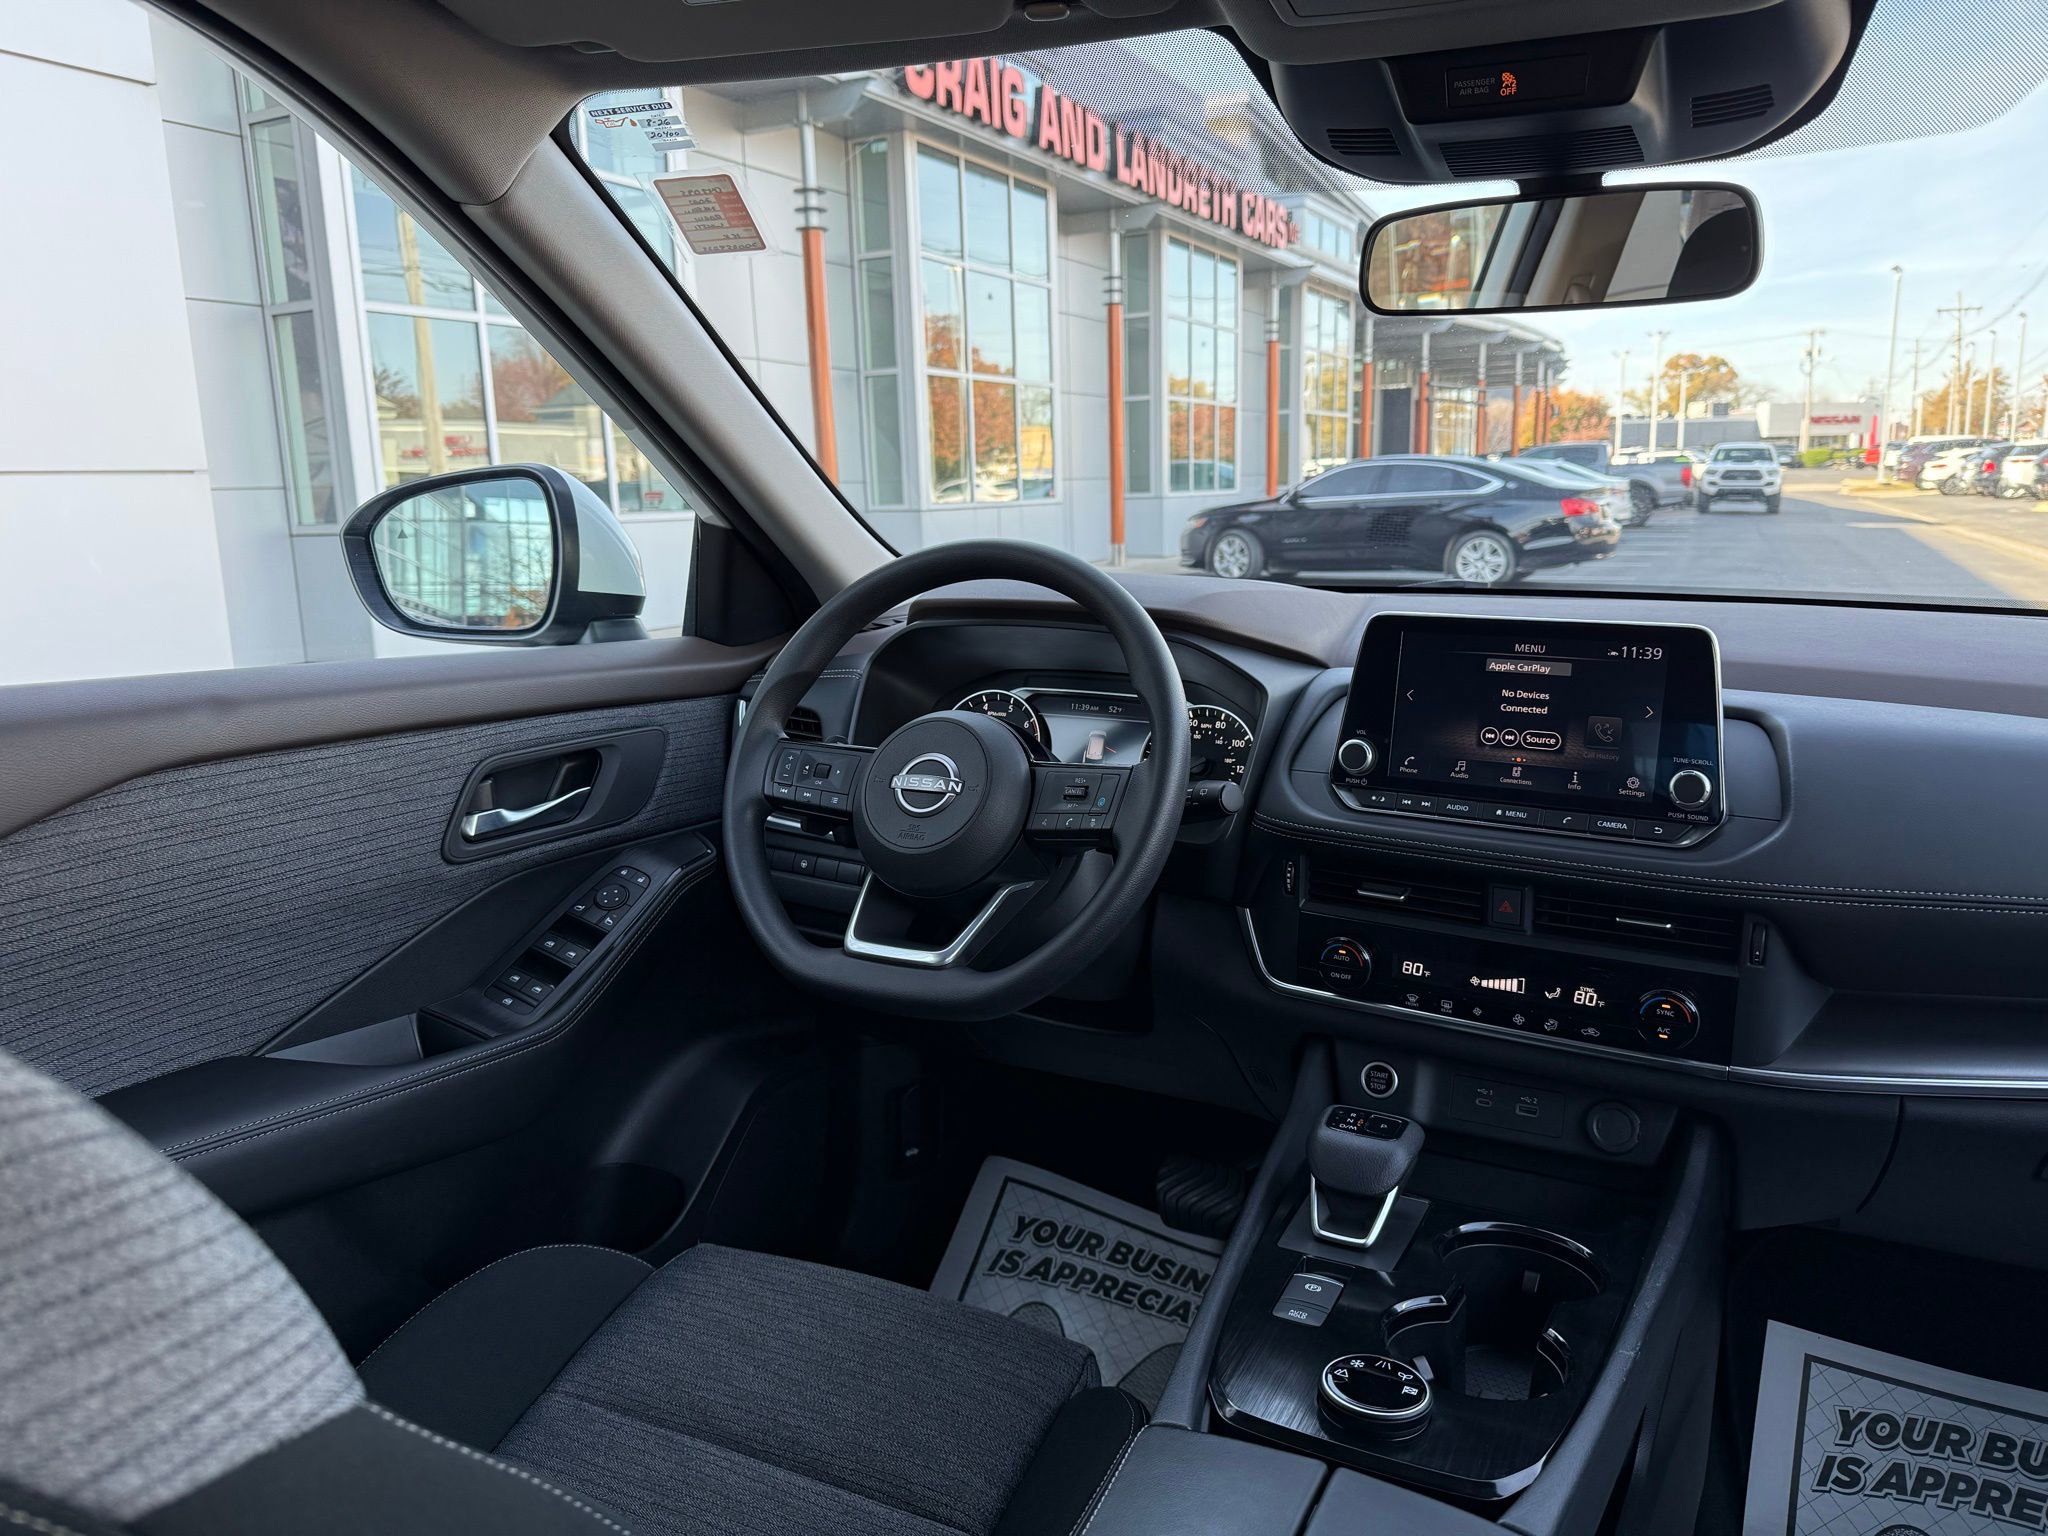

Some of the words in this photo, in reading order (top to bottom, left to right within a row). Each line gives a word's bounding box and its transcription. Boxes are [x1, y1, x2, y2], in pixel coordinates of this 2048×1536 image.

[1454, 77, 1496, 88] PASSENGER
[1459, 88, 1473, 96] AIR
[1474, 86, 1489, 94] BAG
[1500, 88, 1518, 96] OFF
[591, 109, 615, 117] NEXT
[615, 104, 651, 114] SERVICE
[652, 102, 671, 110] DUE
[905, 57, 1027, 138] CRAIG
[1038, 85, 1107, 171] AND
[1115, 124, 1237, 230] LANDRETH
[1242, 192, 1289, 249] CARS
[1514, 643, 1546, 653] MENU
[1621, 646, 1663, 660] 11:39
[1489, 661, 1516, 672] Apple
[1517, 663, 1550, 674] CarPlay
[1501, 689, 1515, 698] No
[1516, 690, 1550, 700] Devices
[983, 703, 988, 711] 4
[1008, 704, 1014, 713] 5
[1500, 704, 1548, 714] Connected
[1024, 720, 1030, 729] 6
[1215, 721, 1227, 729] 80
[1231, 739, 1245, 748] 100
[1525, 734, 1556, 745] Source
[1583, 751, 1597, 759] Call
[1598, 753, 1620, 762] History
[1399, 766, 1418, 774] Phone
[1450, 771, 1469, 779] Audio
[892, 777, 963, 793] NISSAN
[1499, 776, 1532, 786] Connections
[1618, 788, 1645, 797] Settings
[1446, 803, 1469, 812] AUDIO
[1505, 810, 1527, 819] MENU
[1668, 811, 1685, 819] PUSH
[1687, 813, 1709, 821] SOUND
[1597, 820, 1628, 830] CAMERA
[1333, 954, 1350, 962] AUTO
[1656, 1009, 1675, 1017] SYNC
[1657, 1026, 1671, 1034] A/C
[1370, 1070, 1388, 1079] START
[1339, 1123, 1357, 1131] D/M
[1012, 1215, 1105, 1258] YOUR
[1105, 1240, 1211, 1293] BUSIN
[987, 1249, 1028, 1275] IS
[1023, 1256, 1200, 1325] APPRECIA
[1836, 1408, 1972, 1463] YOUR
[1979, 1431, 2048, 1477] BU
[1815, 1455, 1869, 1491] IS
[1869, 1461, 2048, 1526] APPRE
